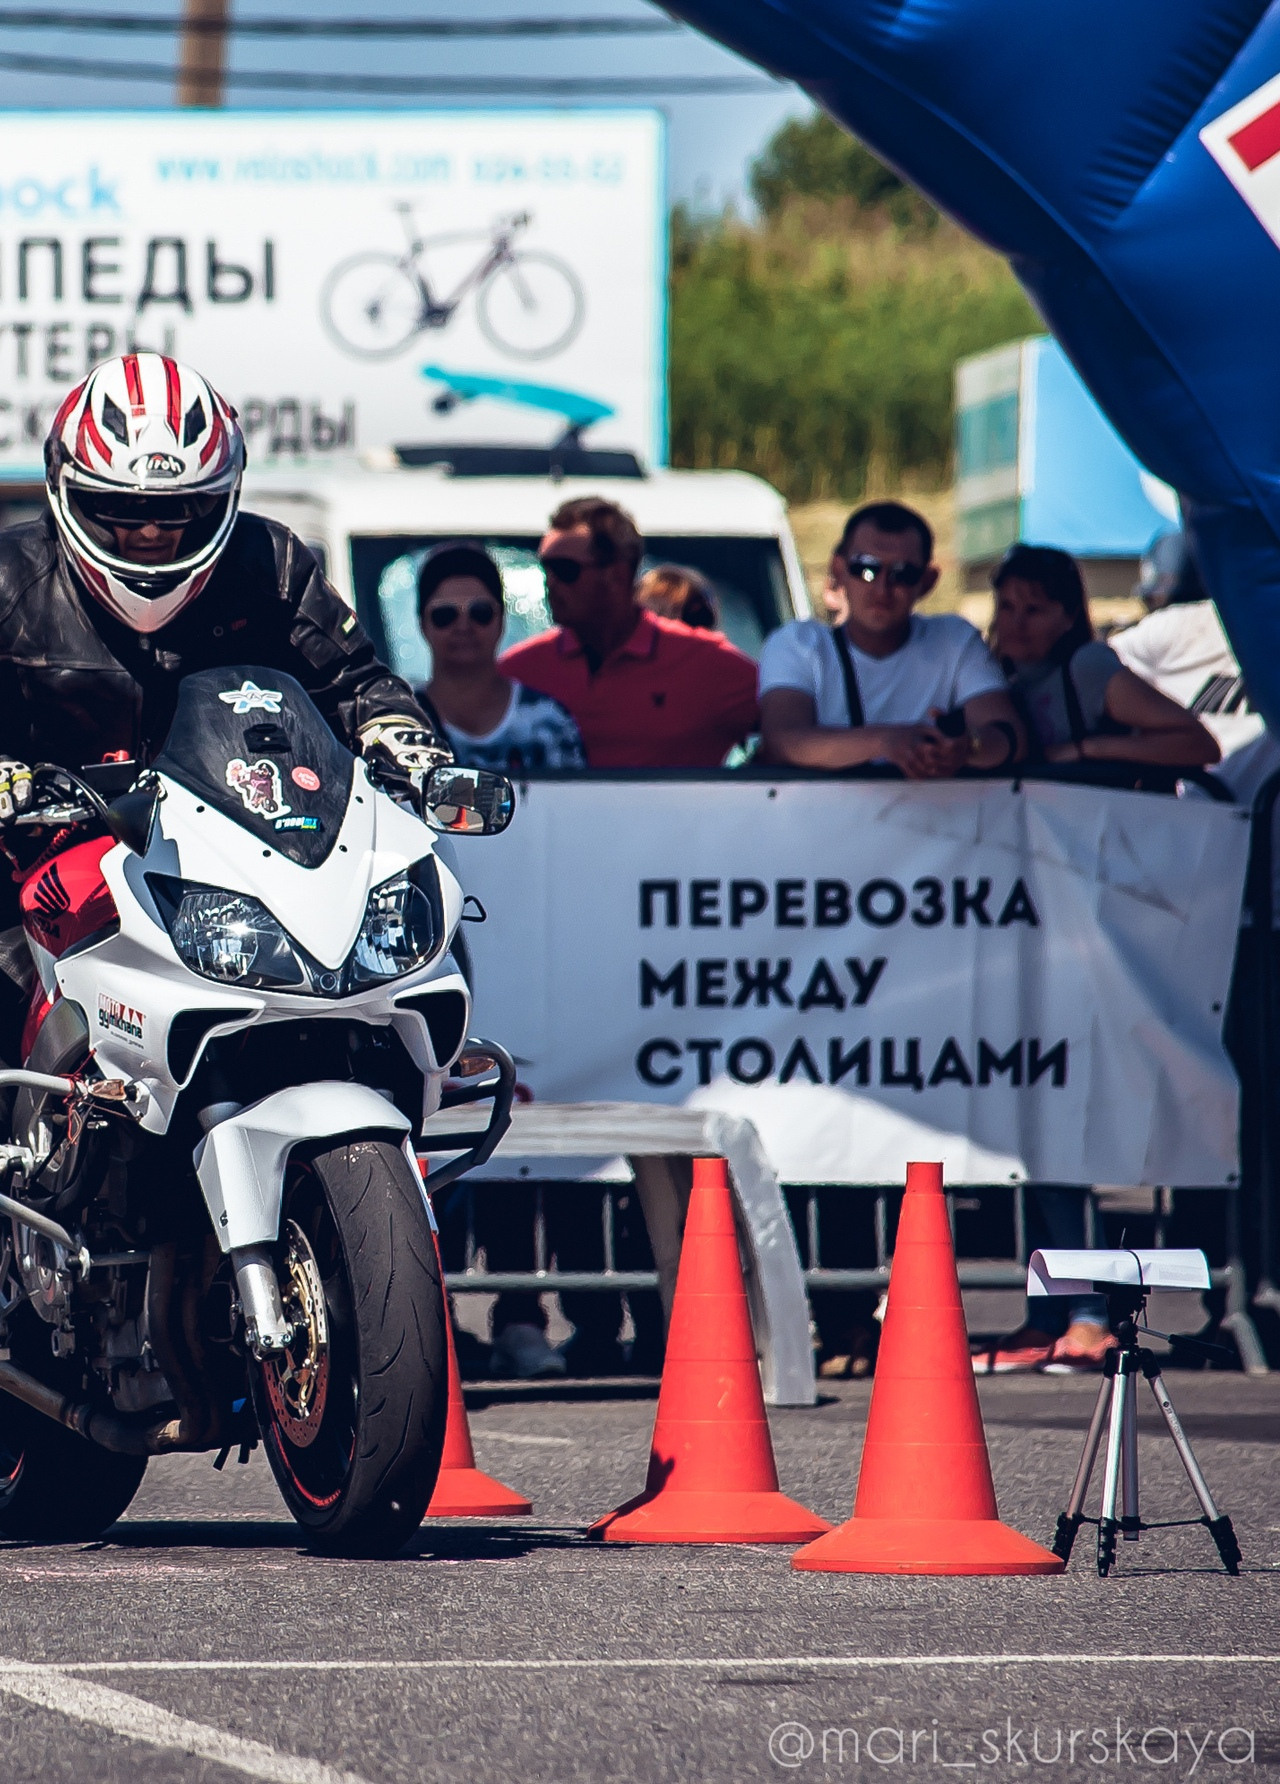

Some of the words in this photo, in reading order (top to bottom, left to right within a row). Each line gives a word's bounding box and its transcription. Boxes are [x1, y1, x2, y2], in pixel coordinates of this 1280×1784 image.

[638, 875, 1041, 930] ПЕРЕВОЗКА
[638, 956, 888, 1013] МЕЖДУ
[635, 1037, 1069, 1091] СТОЛИЦАМИ
